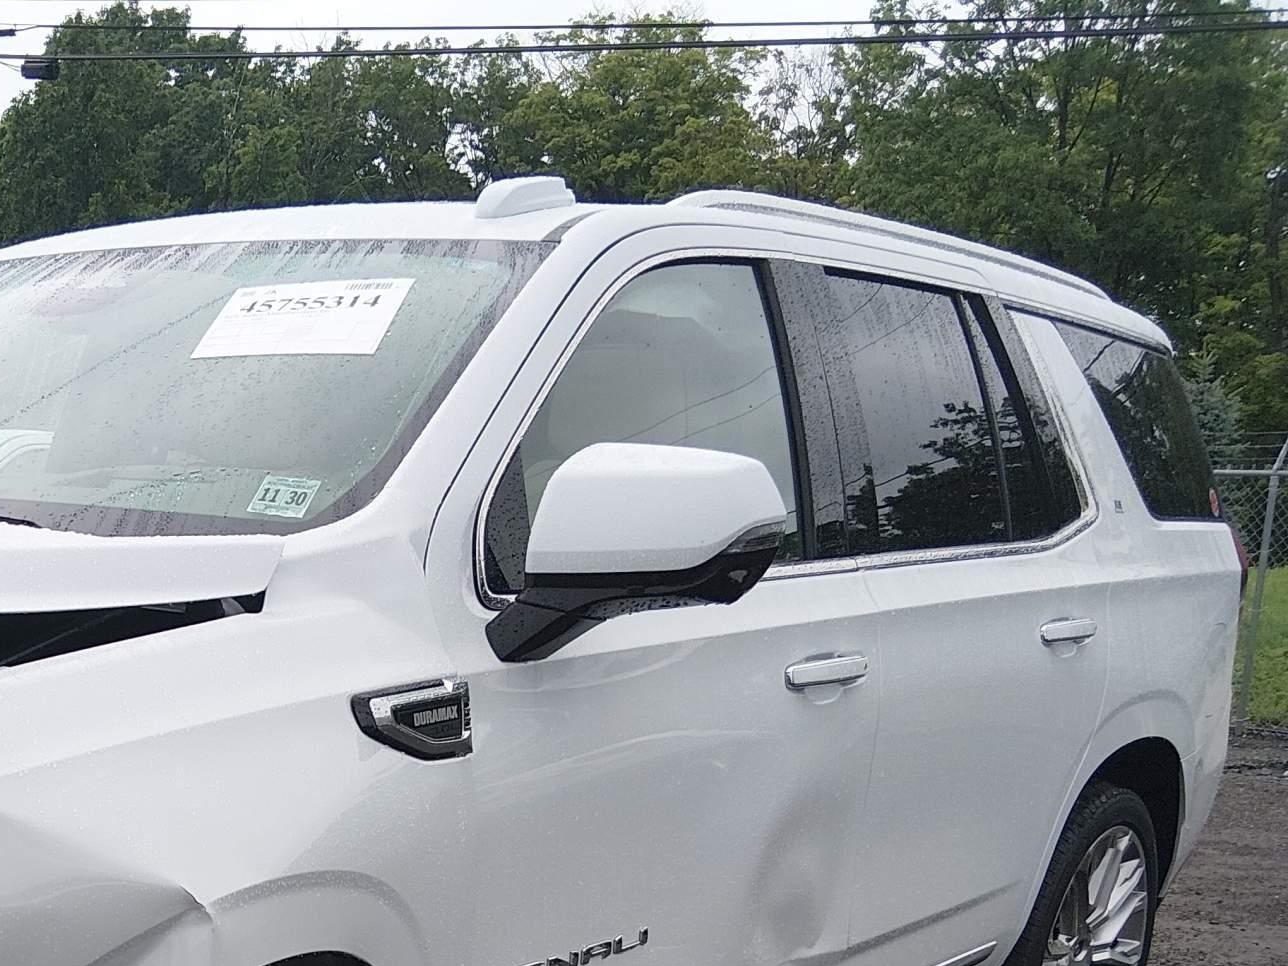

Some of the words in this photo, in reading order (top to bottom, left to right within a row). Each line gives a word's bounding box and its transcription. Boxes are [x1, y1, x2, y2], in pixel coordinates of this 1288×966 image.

[240, 294, 383, 314] 45755314
[257, 487, 281, 503] 11
[285, 490, 308, 506] 30
[413, 705, 458, 727] DURAMAX
